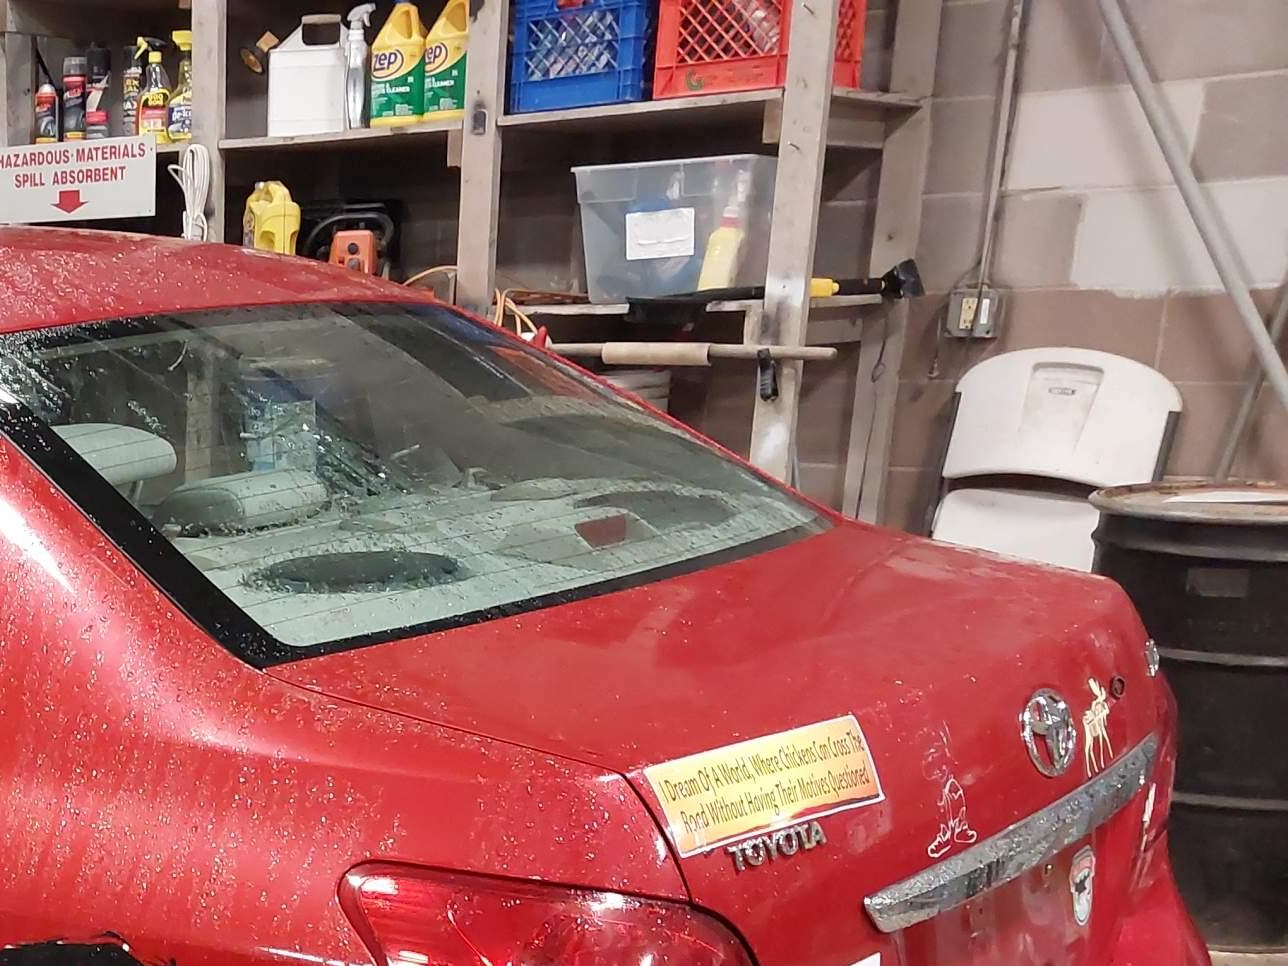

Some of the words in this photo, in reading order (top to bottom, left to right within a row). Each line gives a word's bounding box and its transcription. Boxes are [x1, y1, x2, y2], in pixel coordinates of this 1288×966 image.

[14, 172, 46, 188] SPILL
[52, 166, 126, 186] ABSORBENT
[75, 143, 146, 163] MATERIALS
[664, 776, 702, 802] Dream
[698, 766, 717, 797] Of
[711, 767, 724, 789] A
[719, 757, 756, 785] World,
[748, 753, 783, 777] Where
[778, 743, 817, 769] Chickens
[813, 740, 832, 761] Can
[827, 736, 851, 758] Cross
[845, 729, 865, 752] The
[680, 803, 710, 833] Road
[706, 795, 748, 825] Without
[745, 786, 780, 816] Having
[775, 779, 799, 806] Their
[796, 773, 831, 800] Motives
[827, 760, 870, 798] Questioned
[727, 821, 827, 871] TOYOTA
